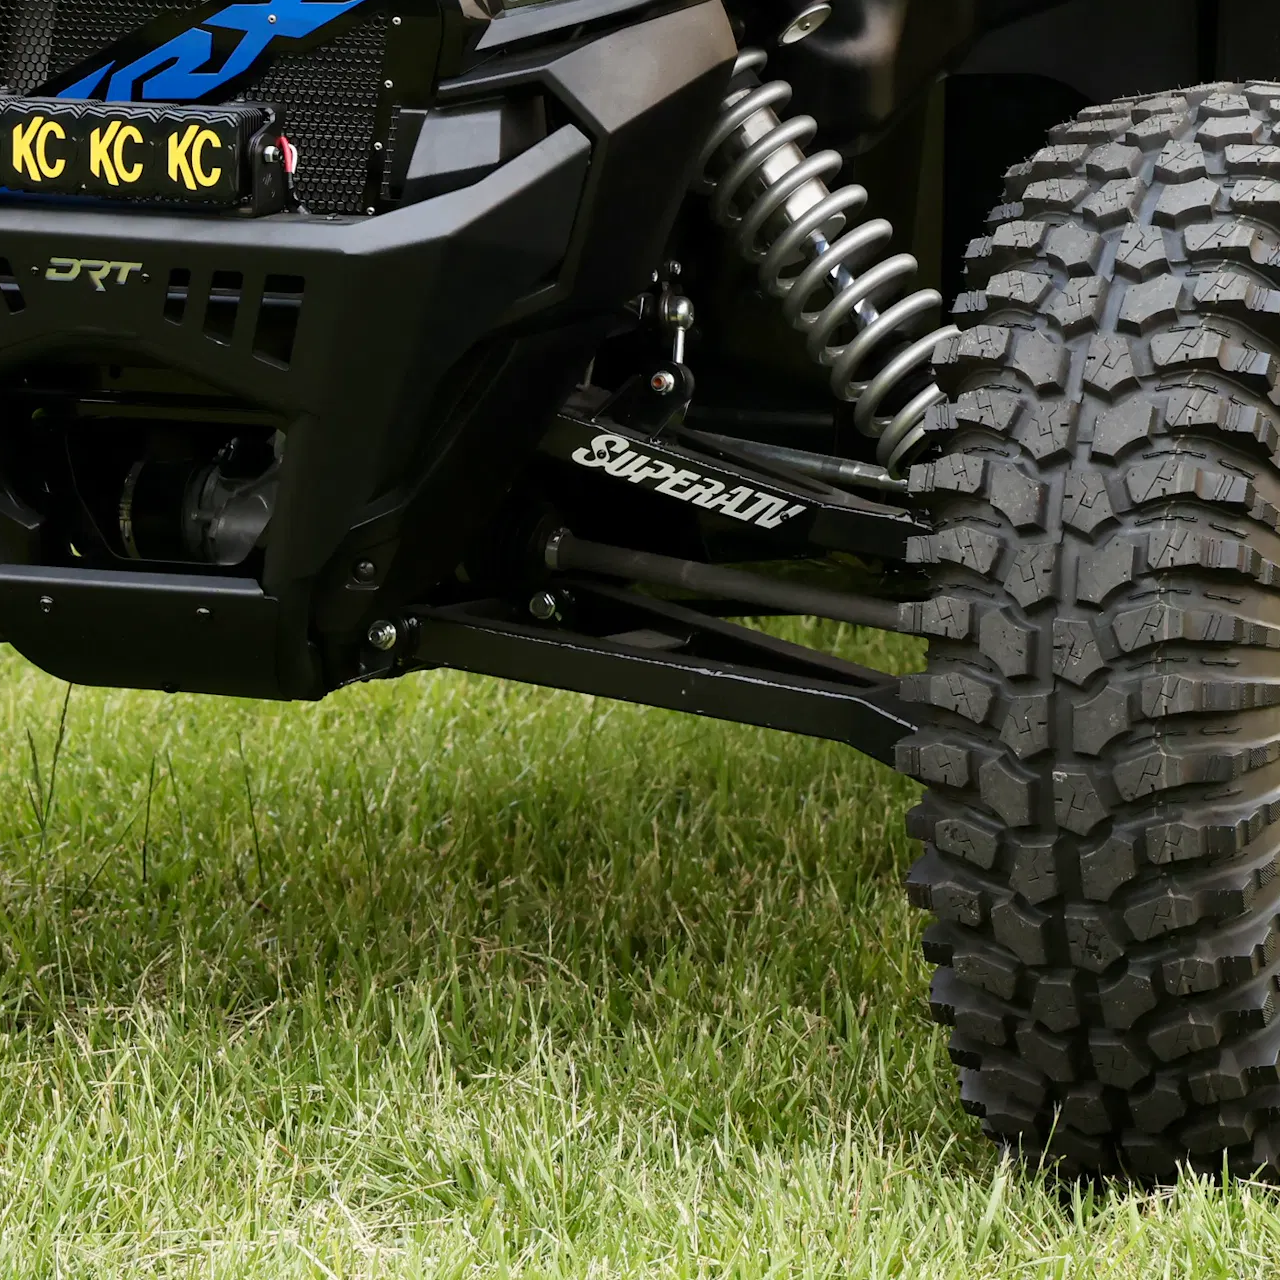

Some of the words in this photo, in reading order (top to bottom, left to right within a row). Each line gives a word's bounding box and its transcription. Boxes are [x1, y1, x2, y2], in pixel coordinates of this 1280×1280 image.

[12, 116, 66, 181] KC
[90, 121, 144, 186] KC
[168, 125, 222, 191] KC
[45, 257, 143, 292] DRT
